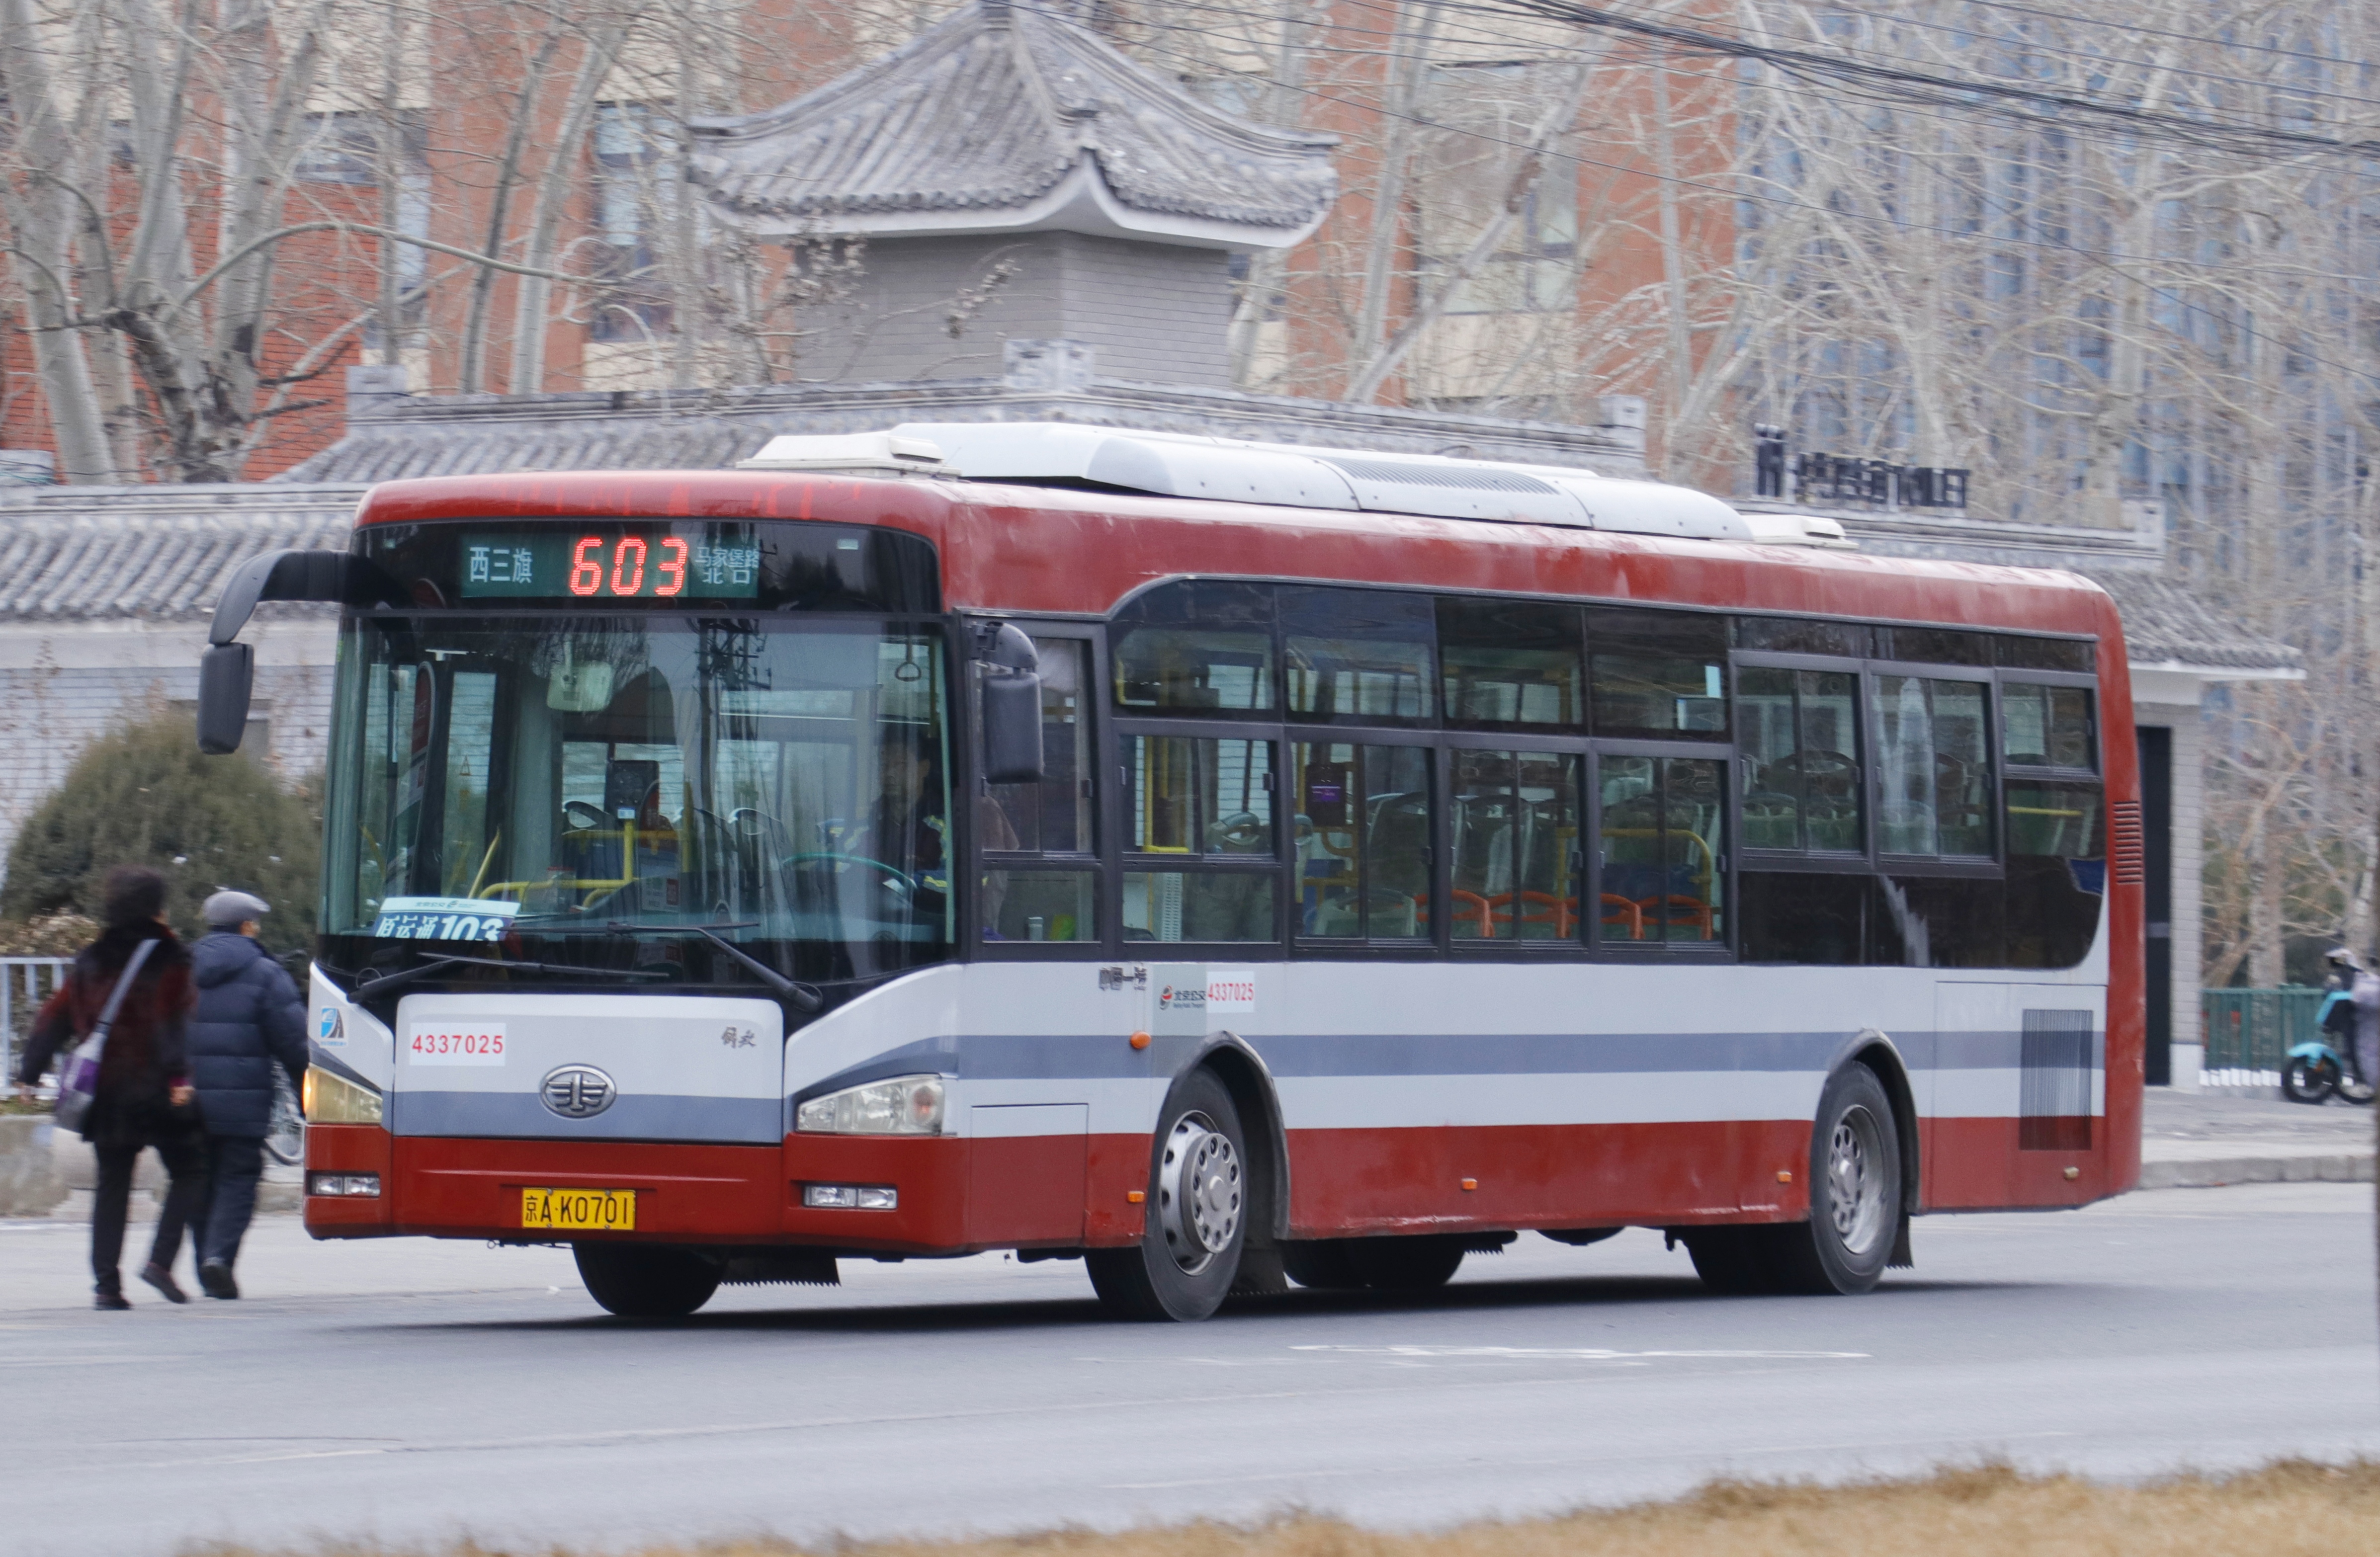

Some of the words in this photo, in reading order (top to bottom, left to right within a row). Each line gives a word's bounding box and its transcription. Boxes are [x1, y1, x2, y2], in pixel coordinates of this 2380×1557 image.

[469, 546, 533, 583] 西三旗
[569, 537, 688, 595] 603
[694, 547, 760, 568] 马家堡路
[702, 568, 751, 584] 北口
[1207, 983, 1255, 1001] 4337025
[412, 1035, 504, 1054] 4337025
